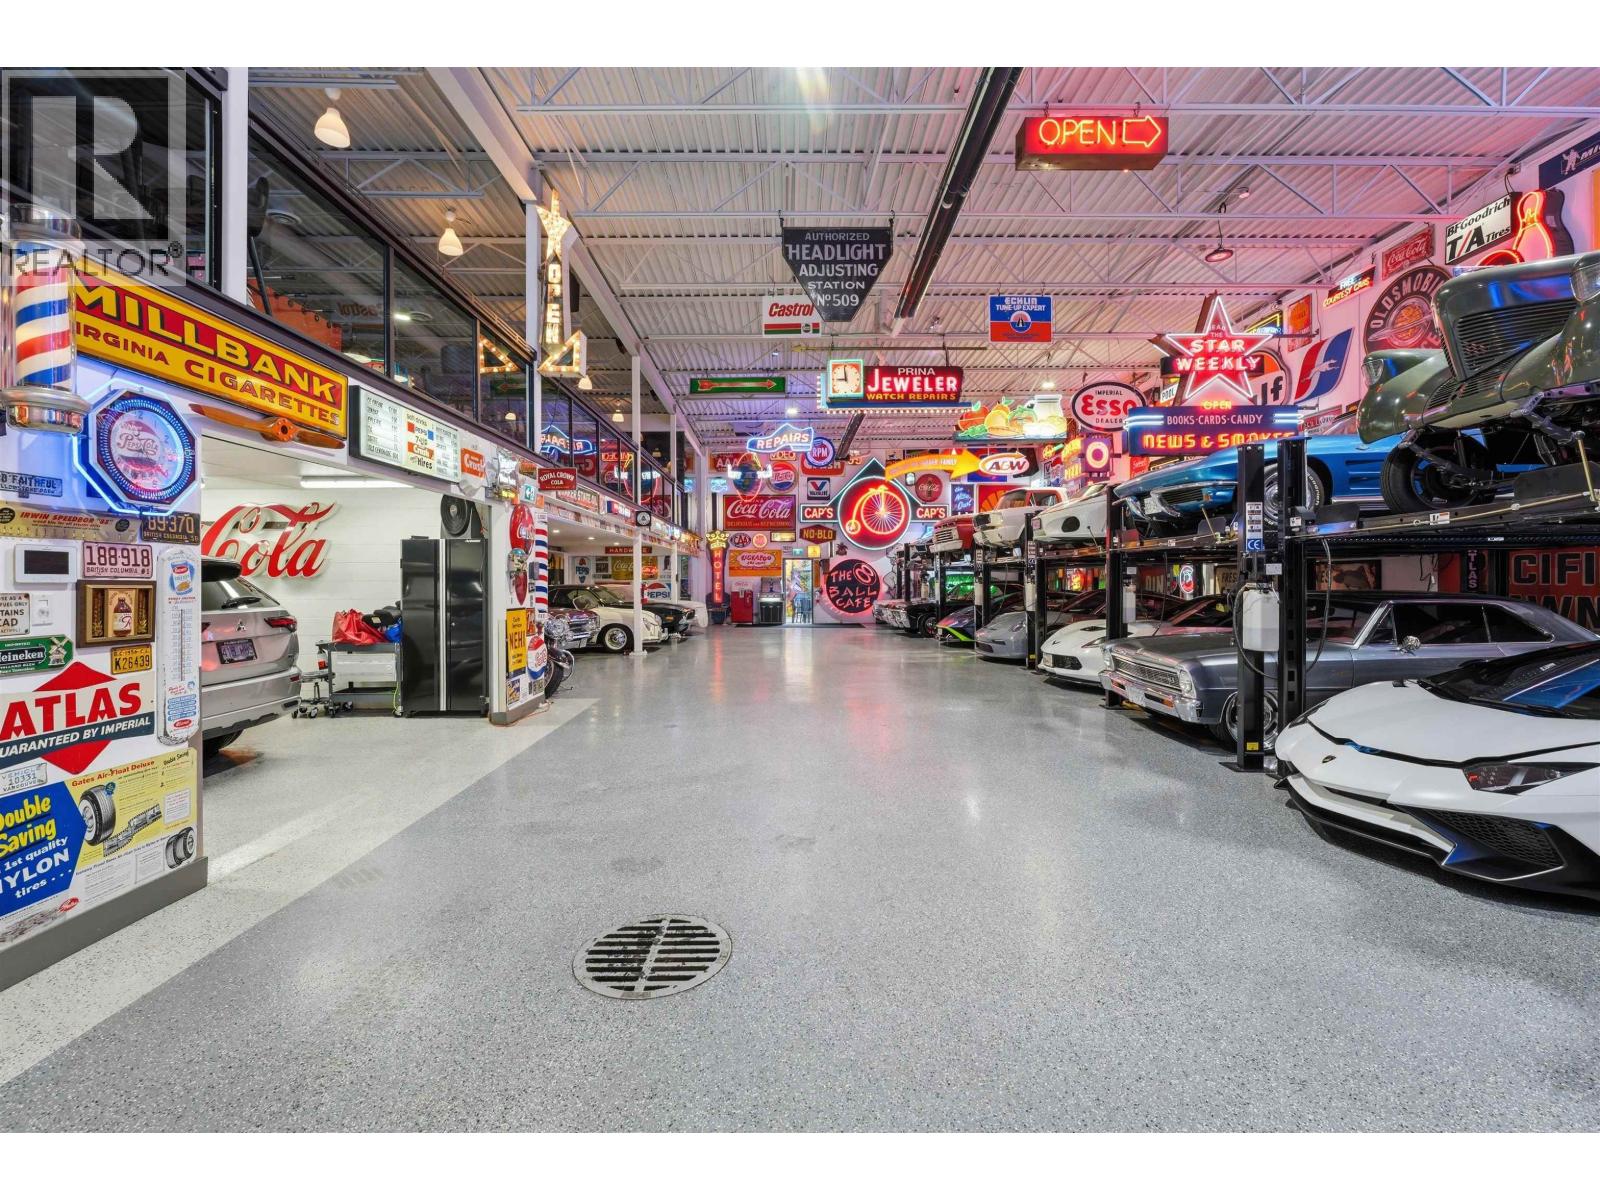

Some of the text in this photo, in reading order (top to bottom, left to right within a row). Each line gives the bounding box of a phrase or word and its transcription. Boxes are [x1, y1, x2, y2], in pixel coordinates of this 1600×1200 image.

[1039, 118, 1117, 146] OPEN
[1447, 197, 1510, 238] BFGoodrich
[804, 232, 870, 242] AUTHORIZED
[1447, 225, 1510, 262] T/A Tires
[785, 243, 887, 261] HEADLIGHT
[800, 263, 879, 277] ADJUSTING
[807, 280, 865, 290] STATION
[768, 302, 815, 318] Castrol
[75, 283, 337, 406] MILLBANK
[1190, 339, 1246, 353] STAR
[1176, 356, 1261, 372] WEEKLY
[76, 321, 341, 427] IRGINIA CIGARETTES
[897, 367, 936, 376] PRINA
[867, 368, 958, 393] JEWELER
[866, 392, 956, 400] WATCH REPAIRS
[1202, 400, 1233, 410] OPEN
[756, 432, 810, 449] REPAIRS
[1142, 431, 1296, 449] NEWS & SMO
[812, 447, 828, 458] RPM
[416, 457, 433, 470] Hires
[989, 460, 1026, 471] A&W
[539, 471, 575, 482] ROYAL CROWN
[20, 511, 50, 521] IRWIN
[804, 507, 834, 519] CAP'S
[916, 507, 946, 519] CAP'S
[1247, 540, 1261, 549] CE
[86, 567, 109, 575] BRITISH
[575, 566, 590, 575] PEPSI
[713, 551, 722, 601] HOTEL
[1512, 552, 1596, 586] CIFI
[831, 570, 851, 583] THE
[829, 586, 877, 599] BALL
[836, 598, 871, 608] CAFE
[0, 609, 25, 617] TAINS
[509, 630, 526, 650] NEHI
[0, 649, 44, 663] eineken
[114, 654, 151, 671] K26439
[0, 682, 142, 741] ATLAS
[0, 732, 80, 759] UARANTEED
[83, 726, 99, 738] BY
[100, 716, 151, 737] IMPERIAL
[72, 776, 95, 787] Gates
[131, 760, 155, 771] Deluxe
[0, 818, 57, 857] Saving
[4, 858, 23, 872] 1st
[25, 836, 69, 863] quality
[15, 876, 48, 899] tires
